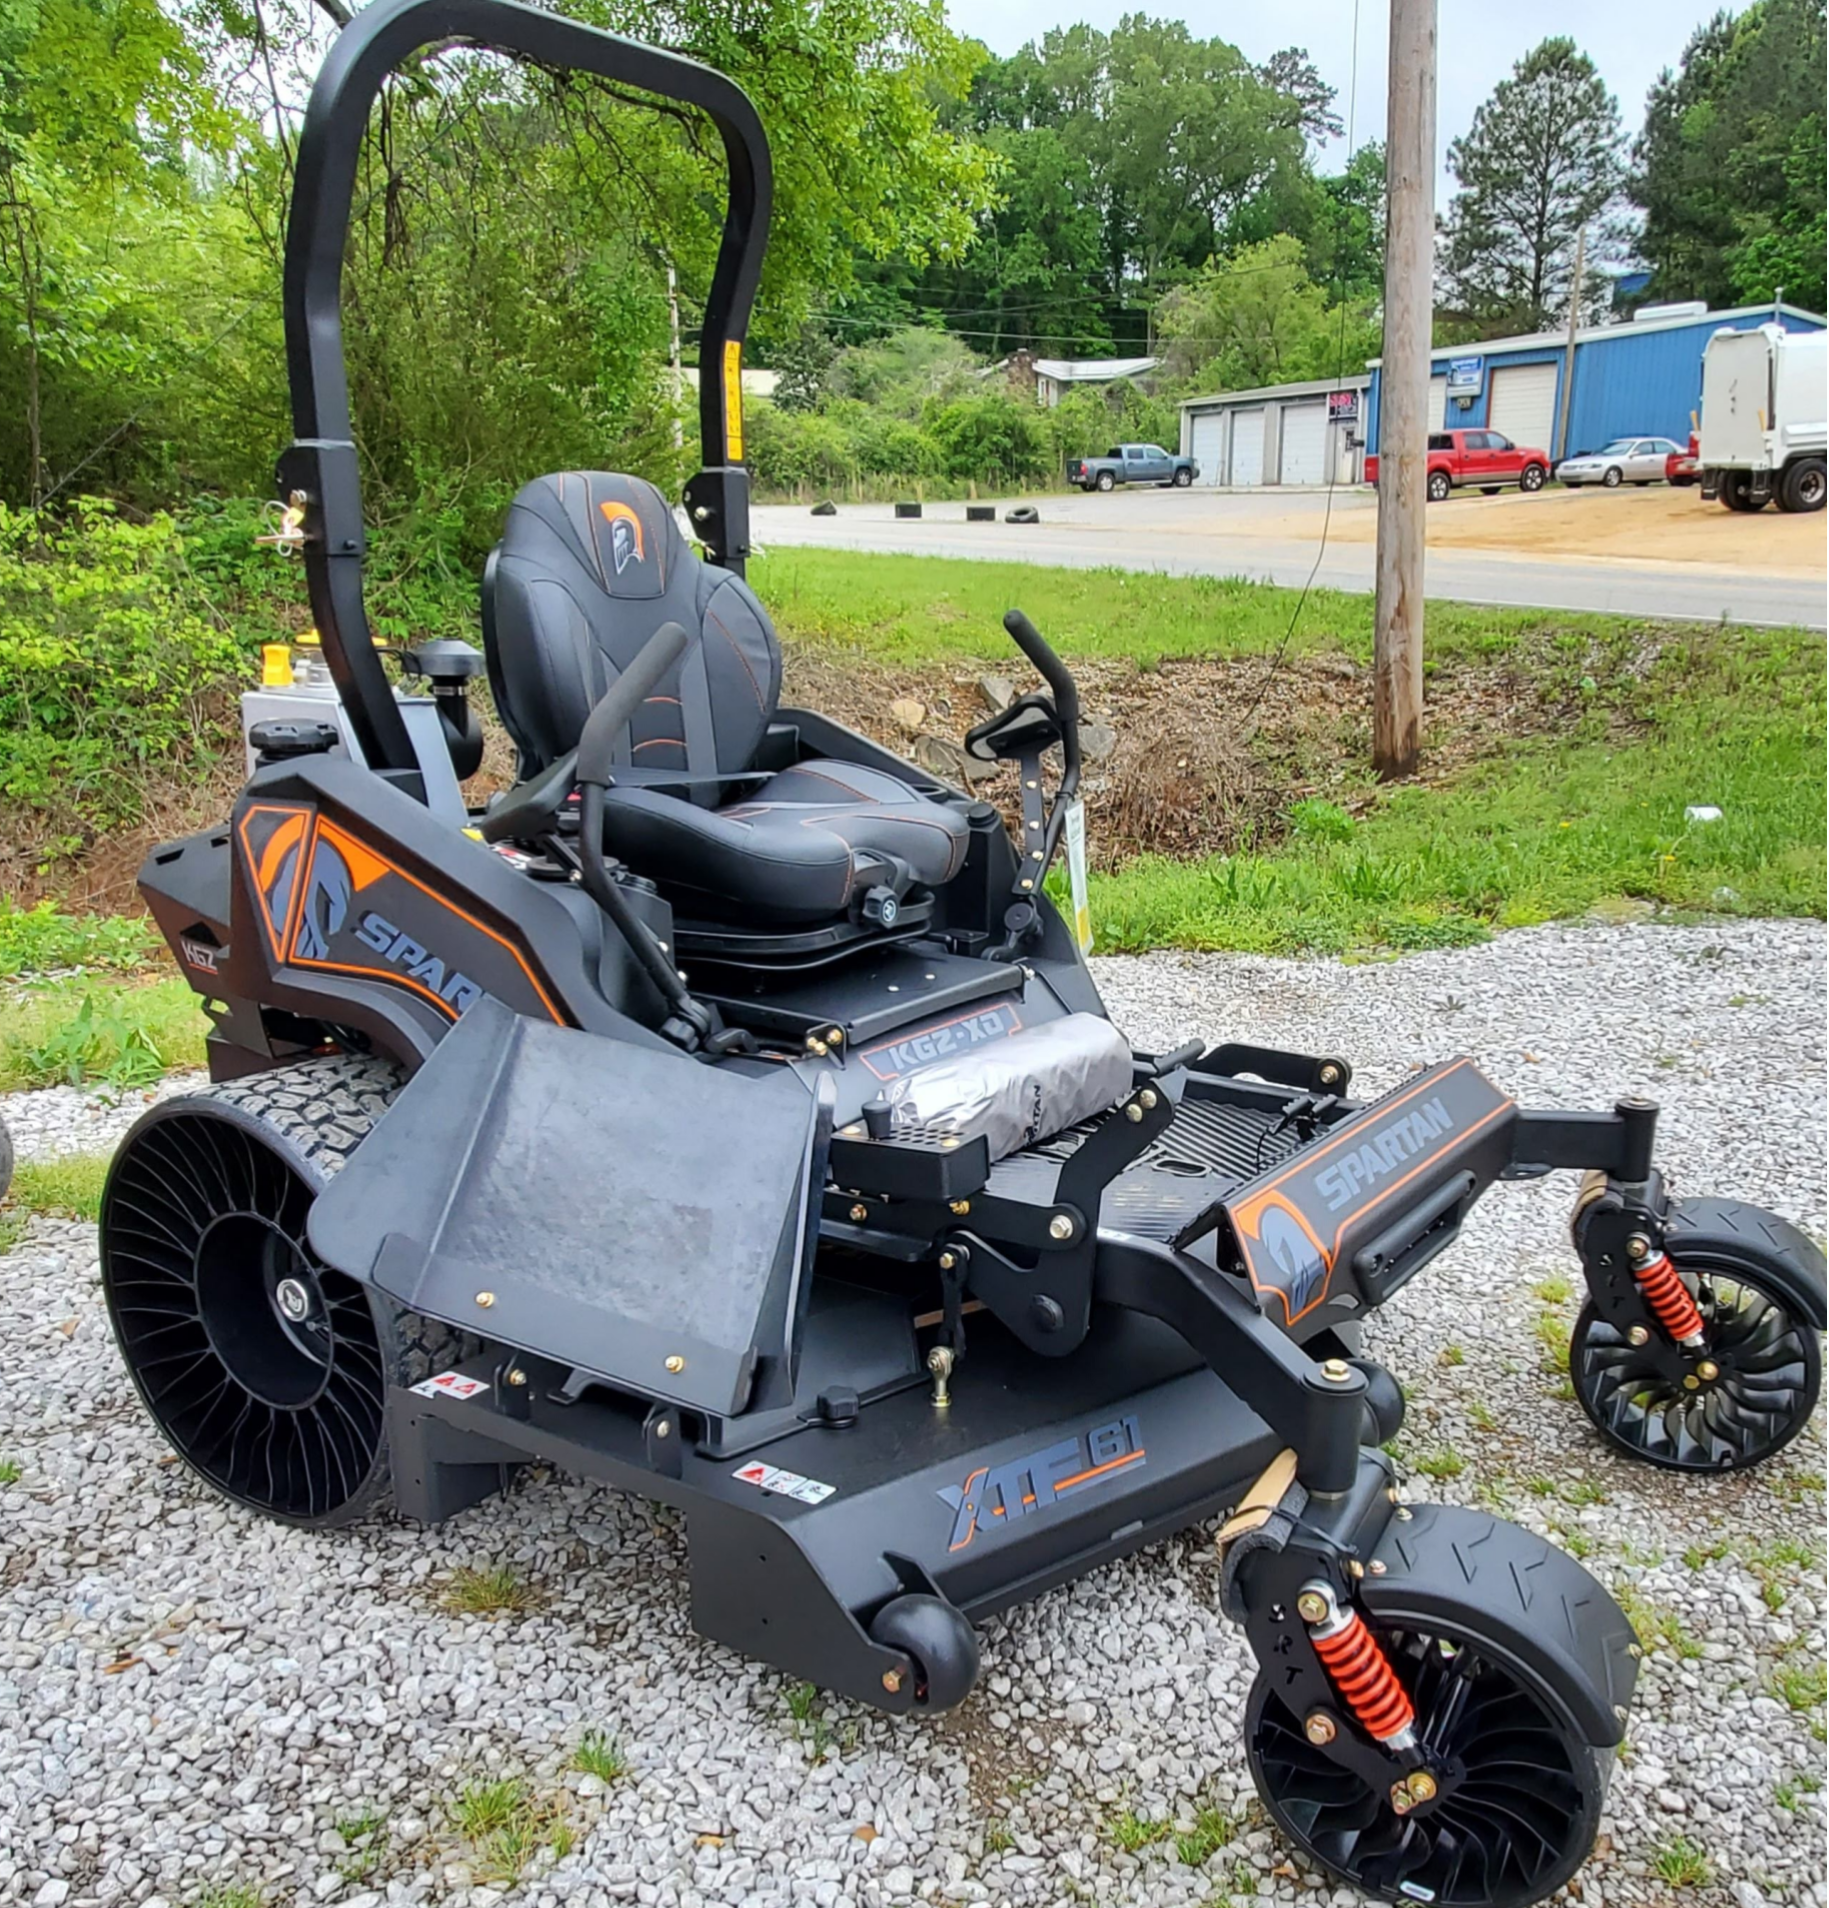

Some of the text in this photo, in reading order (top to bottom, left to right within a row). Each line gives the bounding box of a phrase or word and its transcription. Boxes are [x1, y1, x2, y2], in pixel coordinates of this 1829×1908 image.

[181, 939, 218, 971] KGZ
[354, 912, 484, 1013] SPAR
[1314, 1096, 1455, 1212] SPARTAN
[936, 1416, 1144, 1552] XTF 61
